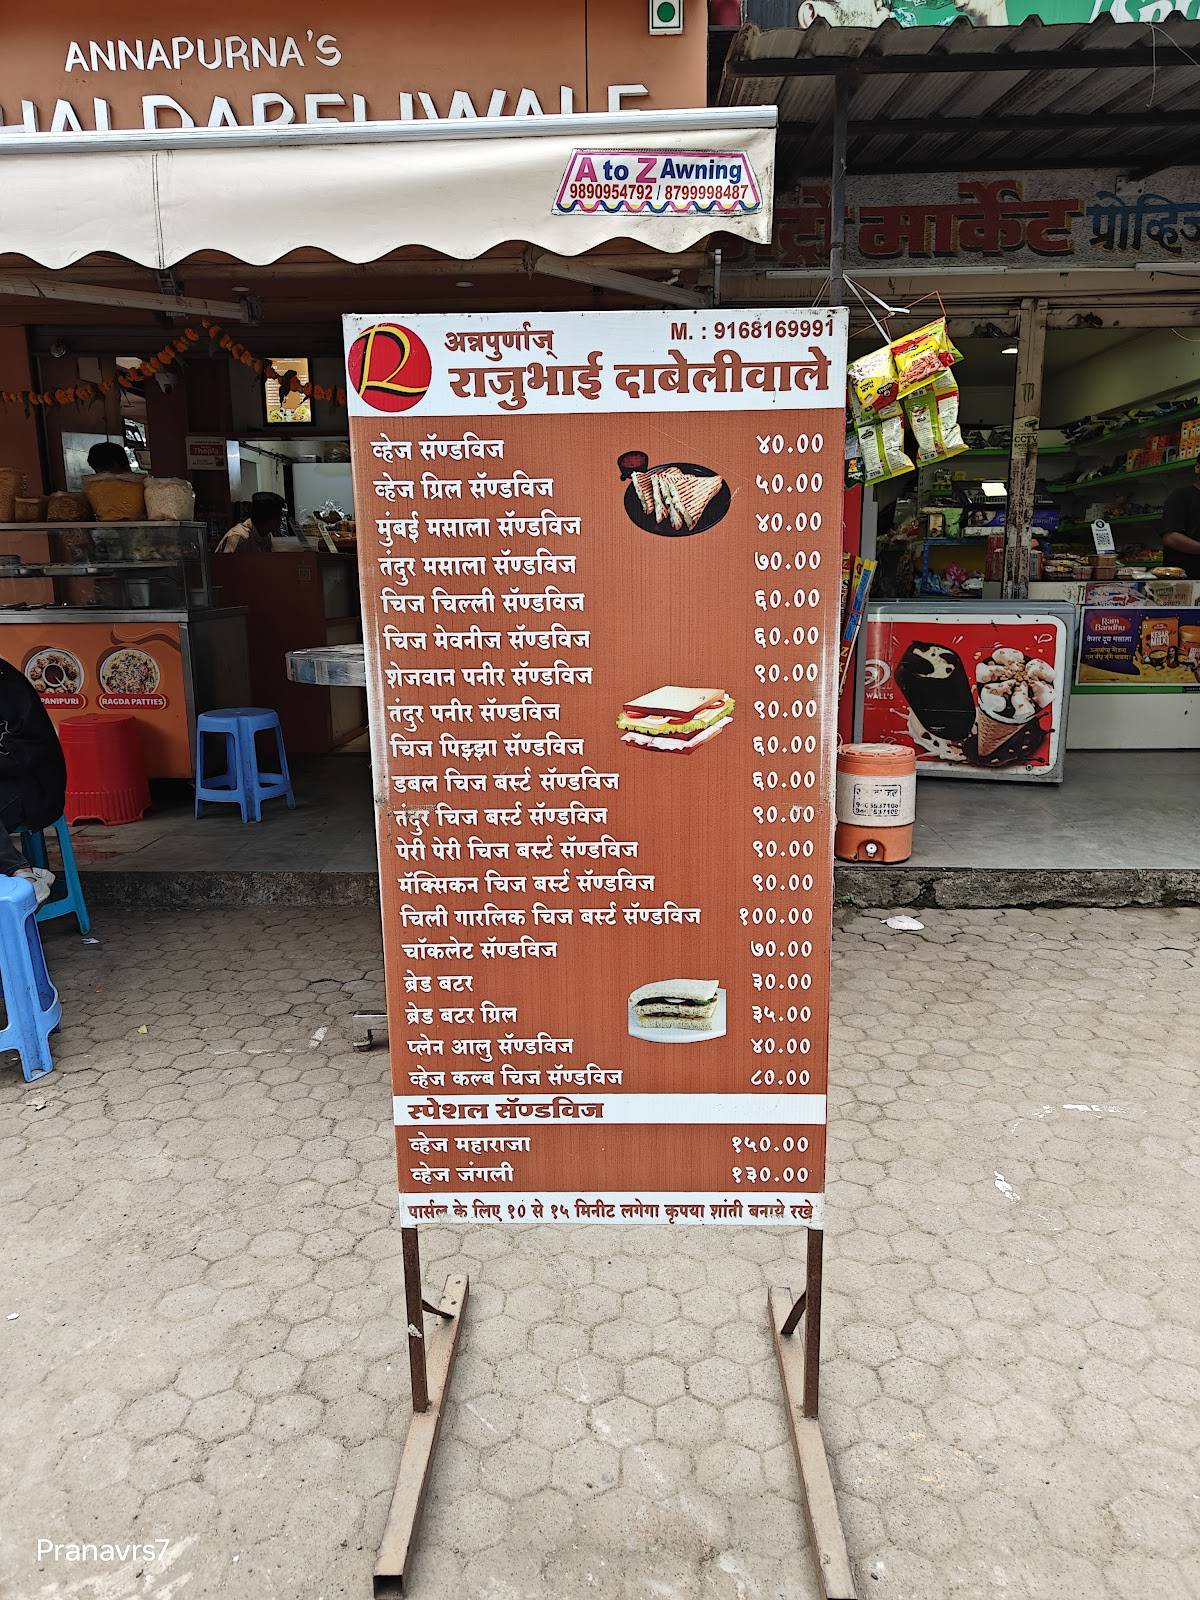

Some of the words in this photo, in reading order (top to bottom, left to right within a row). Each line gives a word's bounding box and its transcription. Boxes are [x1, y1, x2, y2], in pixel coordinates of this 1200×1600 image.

[65, 28, 342, 72] ANNAPURNA'S
[575, 157, 597, 182] A
[603, 160, 629, 180] to
[636, 158, 657, 183] Z
[660, 159, 742, 183] Awning
[570, 184, 653, 200] 9890954792
[665, 185, 748, 199] 8799998487
[859, 179, 1085, 258] मार्केट
[714, 320, 834, 340] 9168169991
[449, 350, 602, 410] राजुभाई
[615, 346, 832, 399] दाबेलीवाले
[370, 433, 412, 463] व्हेज
[418, 432, 504, 460] सॅण्डविज
[373, 472, 414, 502] व्हेज
[420, 472, 462, 499] ग्रिल
[468, 470, 554, 498] सॅण्डविज
[375, 511, 419, 547] मुंबई
[425, 519, 490, 538] मसाला
[496, 509, 582, 537] सॅण्डविज
[378, 549, 416, 586] तंदुर
[421, 557, 486, 576] मसाला
[492, 548, 576, 575] सॅण्डविज
[380, 587, 425, 613] चिज
[431, 587, 495, 613] चिल्ली
[501, 585, 585, 613] सॅण्डविज
[382, 625, 427, 650] चिज
[433, 624, 501, 650] मेवनीज
[507, 623, 591, 649] सॅण्डविज
[384, 661, 455, 688] शेजवान
[461, 661, 505, 686] पनीर
[511, 660, 593, 686] सॅण्डविज
[387, 698, 424, 732] तंदुर
[429, 698, 473, 722] पनीर
[478, 696, 560, 722] सॅण्डविज
[389, 733, 433, 757] चिज
[503, 731, 584, 757] सॅण्डविज
[391, 776, 438, 793] डबल
[444, 768, 487, 792] चिज
[493, 767, 531, 791] बर्स्ट
[539, 766, 619, 791] सॅण्डविज
[393, 803, 429, 835] तंदुर
[435, 802, 478, 826] चिज
[484, 801, 522, 825] बर्स्ट
[528, 801, 608, 825] सॅण्डविज
[396, 837, 426, 861] पेरी
[431, 837, 461, 860] पेरी
[467, 836, 509, 859] चिज
[515, 835, 553, 859] बर्स्ट
[559, 834, 639, 858] सॅण्डविज
[398, 871, 478, 894] मॅक्सिकन
[484, 870, 527, 893] चिज
[532, 868, 570, 892] बर्स्ट
[576, 868, 655, 892] सॅण्डविज
[400, 904, 448, 927] चिली
[454, 903, 526, 926] गारलिक
[531, 902, 573, 925] चिज
[579, 902, 616, 925] बर्स्ट
[622, 901, 701, 925] सॅण्डविज
[401, 936, 473, 959] चॉकलेट
[480, 935, 558, 959] सॅण्डविज
[403, 970, 431, 992] ब्रेड
[437, 976, 473, 991] बटर
[405, 1002, 433, 1024] ब्रेड
[439, 1008, 474, 1023] बटर
[480, 1001, 517, 1023] ग्रिल
[407, 1034, 444, 1055] प्लेन
[451, 1040, 493, 1062] आलु
[497, 1032, 574, 1055] सॅण्डविज
[408, 1065, 445, 1088] व्हेज
[451, 1071, 494, 1086] कल्ब
[500, 1064, 541, 1085] चिज
[546, 1063, 623, 1085] सॅण्डविज
[407, 1098, 489, 1119] स्पेशल
[495, 1096, 604, 1118] सॅण्डविज
[408, 1132, 448, 1154] व्हेज
[454, 1137, 531, 1154] महाराजा
[410, 1162, 450, 1184] व्हेज
[456, 1161, 514, 1182] जंगली
[409, 1198, 447, 1218] पार्सल
[453, 1199, 468, 1218] के
[473, 1200, 501, 1221] लिए
[532, 1198, 543, 1219] से
[551, 1205, 568, 1219] १५
[575, 1199, 614, 1219] मिनीट
[621, 1199, 659, 1218] लगेगा
[665, 1203, 704, 1224] कृपया
[711, 1198, 743, 1219] शांती
[791, 1200, 813, 1220] रखे
